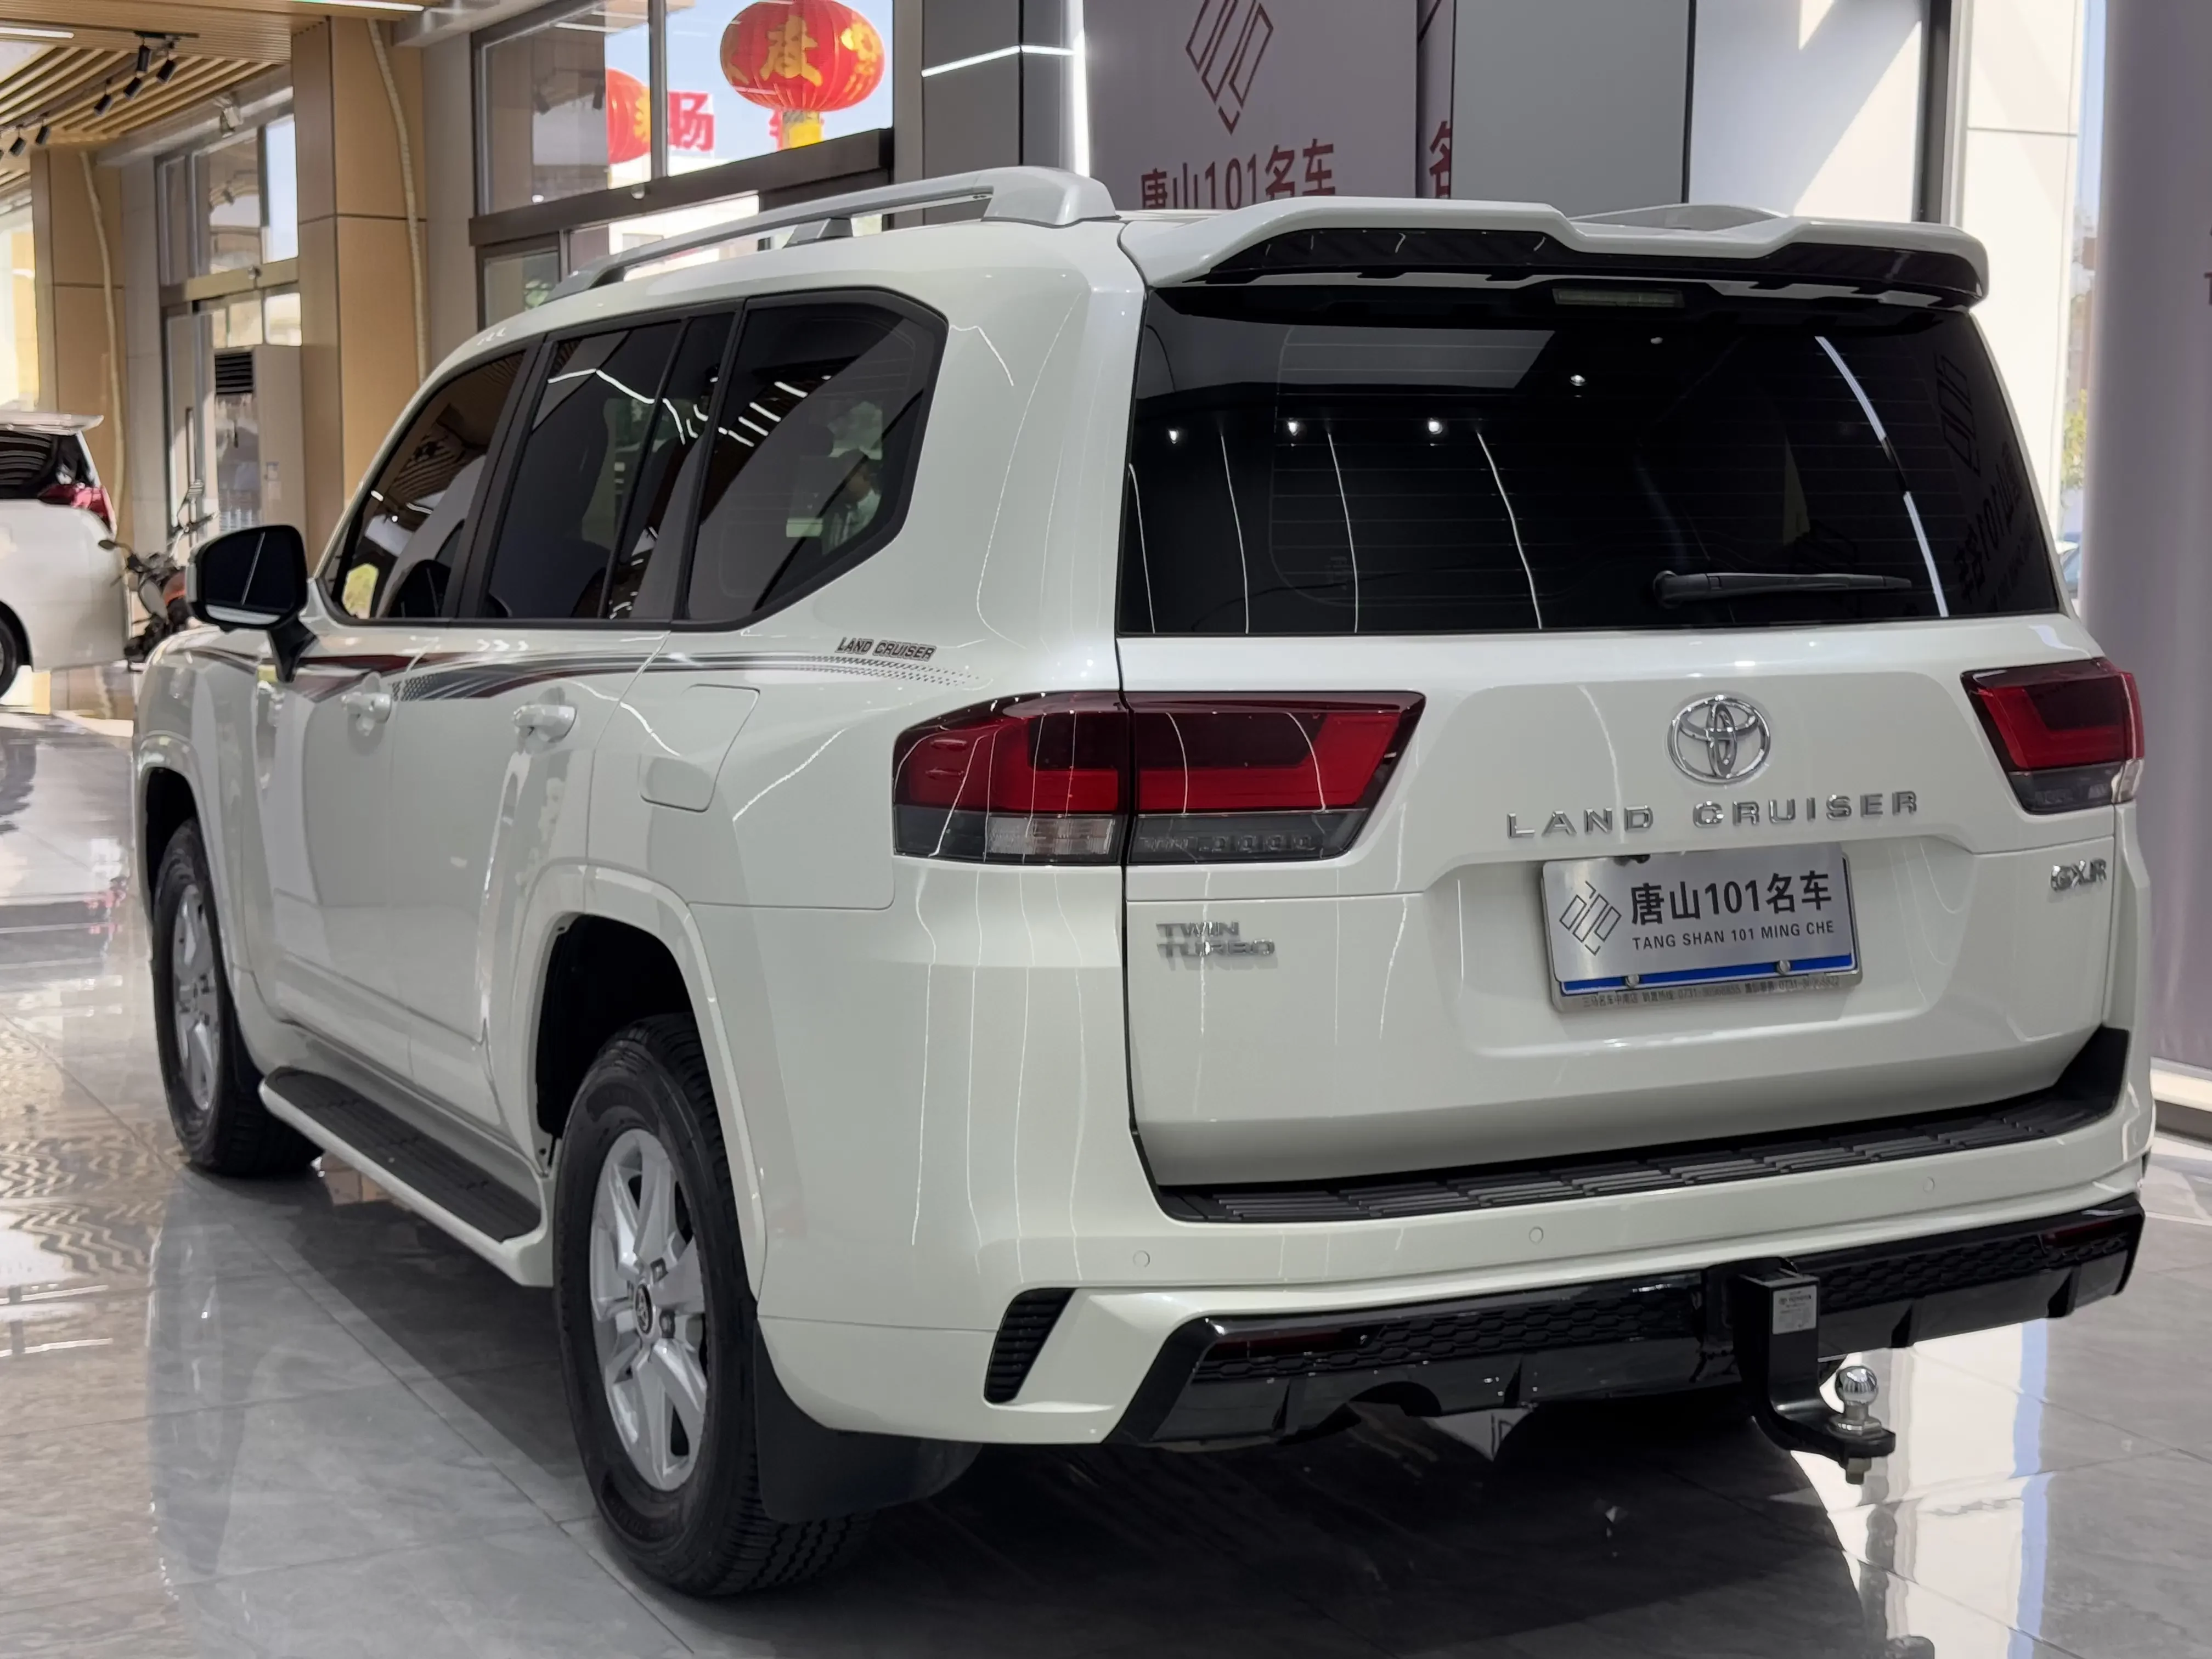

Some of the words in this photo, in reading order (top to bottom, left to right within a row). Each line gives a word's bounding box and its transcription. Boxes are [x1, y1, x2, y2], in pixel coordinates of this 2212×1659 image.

[1141, 139, 1335, 209] 唐山101名车
[835, 637, 874, 654] LAND
[872, 640, 936, 662] CRUISER
[1507, 805, 1654, 838] LAND
[1692, 791, 1917, 827] CRUISER
[1631, 870, 1832, 926] 唐山101名车
[1156, 921, 1239, 937] TWIN
[1632, 934, 1676, 950] TANG
[1683, 930, 1725, 946] SHAN
[1733, 928, 1754, 942] 101
[1761, 923, 1801, 939] MING
[1806, 920, 1835, 935] CHE
[1156, 939, 1276, 957] TURBO
